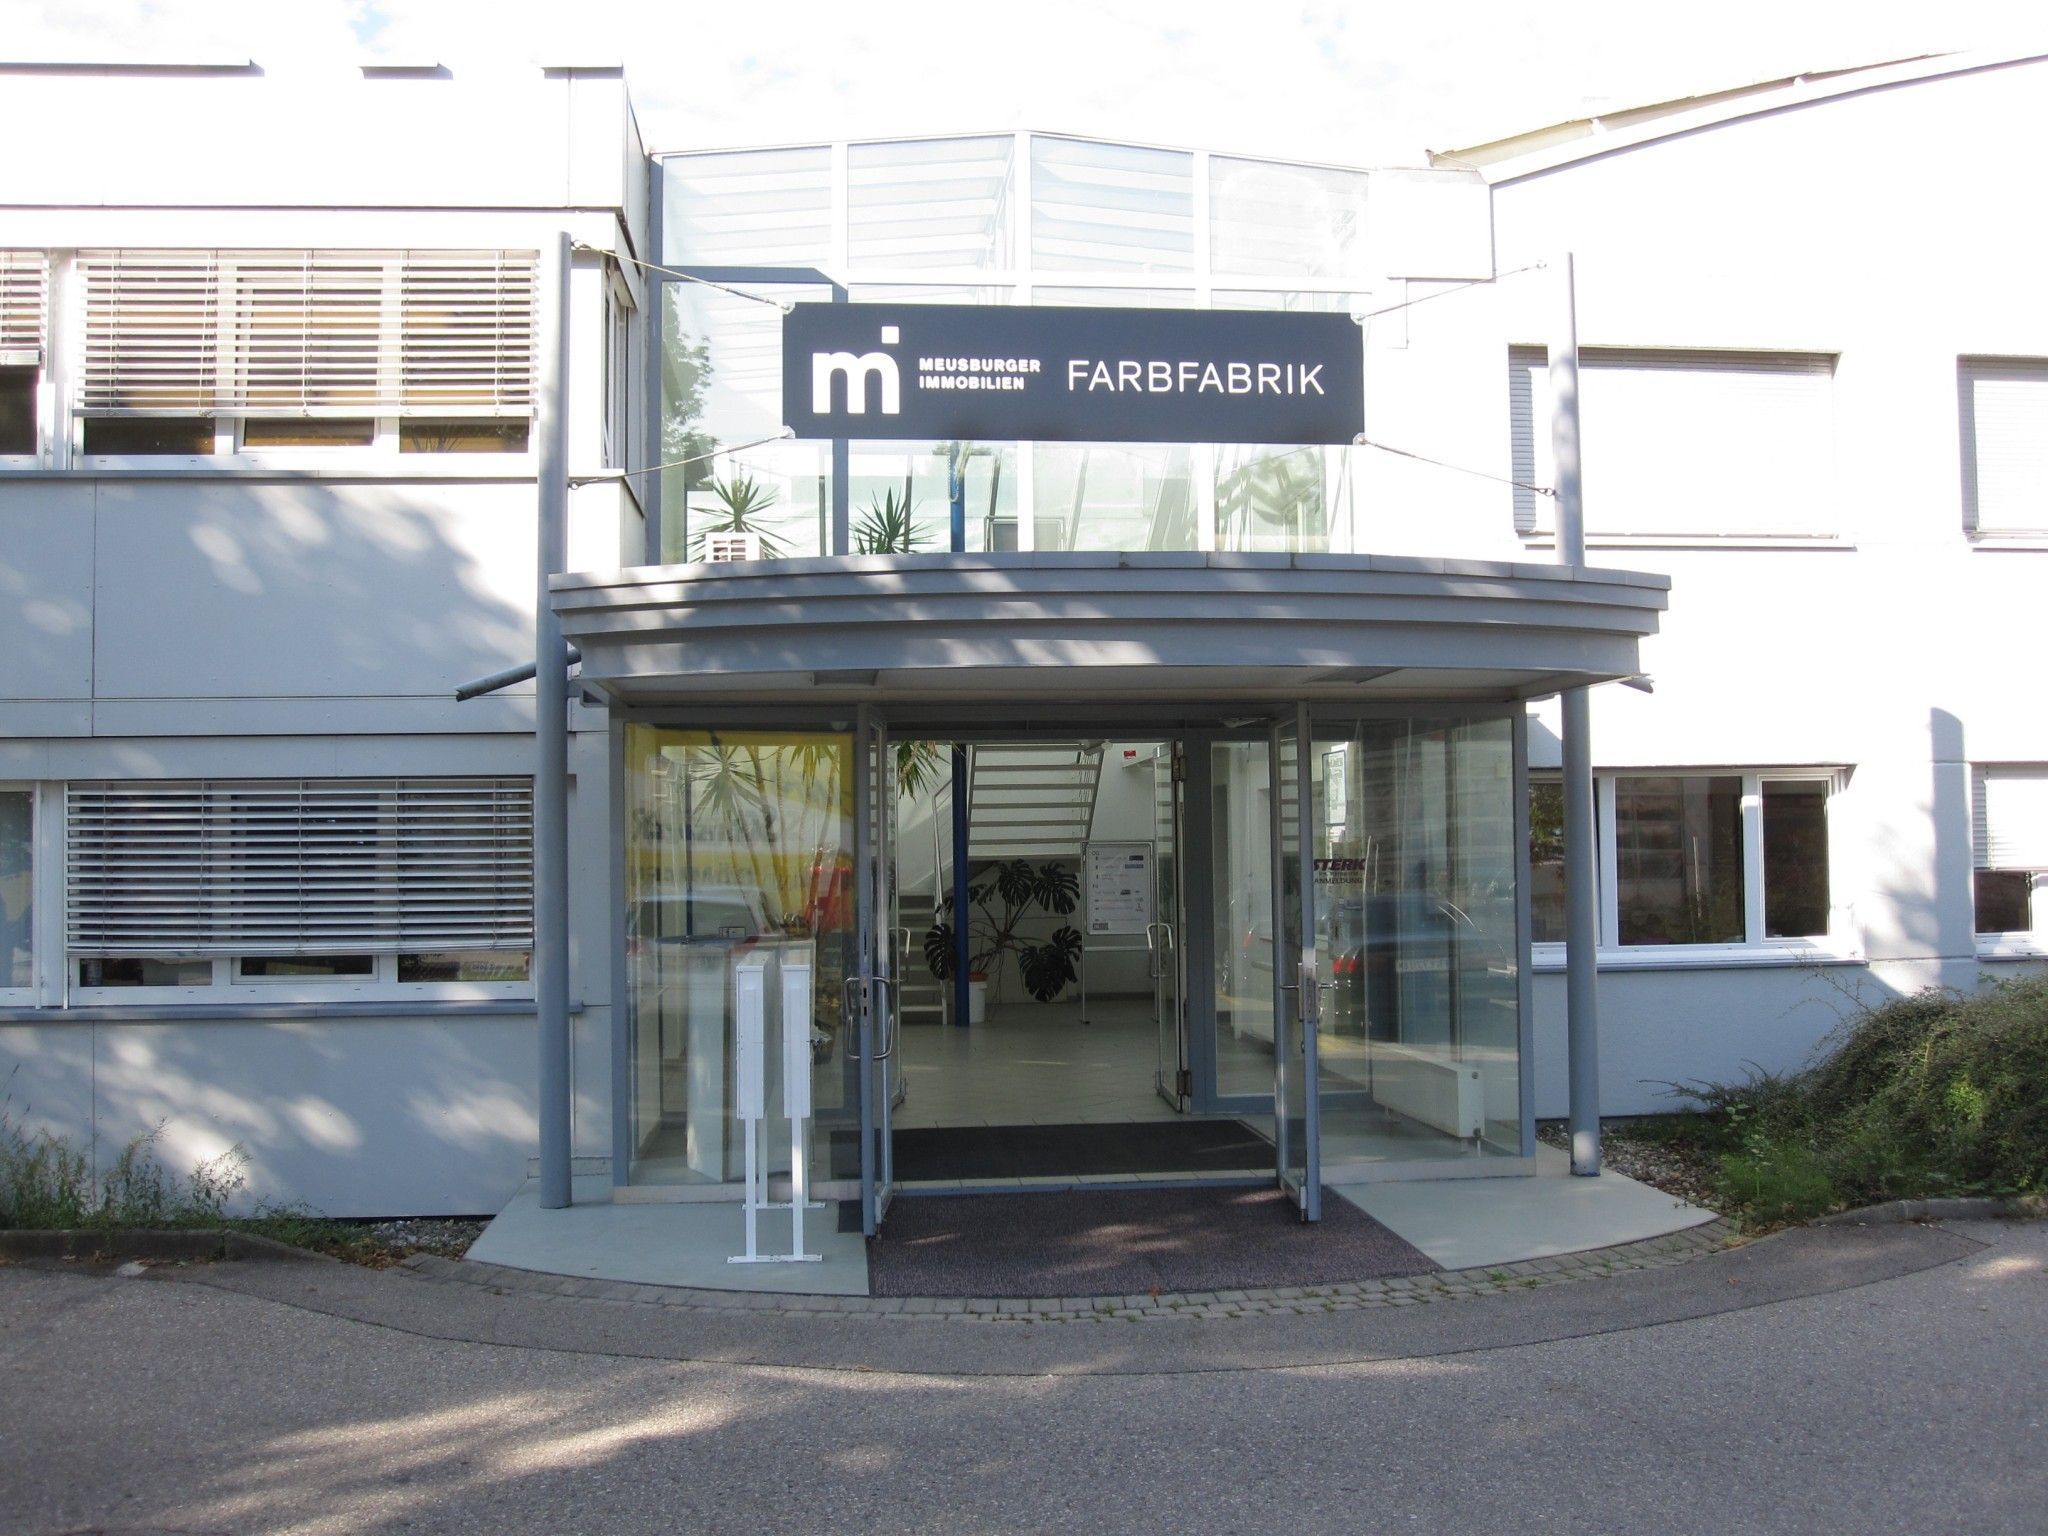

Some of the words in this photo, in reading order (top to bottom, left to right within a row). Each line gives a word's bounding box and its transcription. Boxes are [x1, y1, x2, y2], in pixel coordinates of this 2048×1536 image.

[919, 357, 1041, 372] MEUSBURGER
[919, 375, 1025, 390] IMMOBILIEN
[1068, 359, 1325, 395] FARBFABRIK
